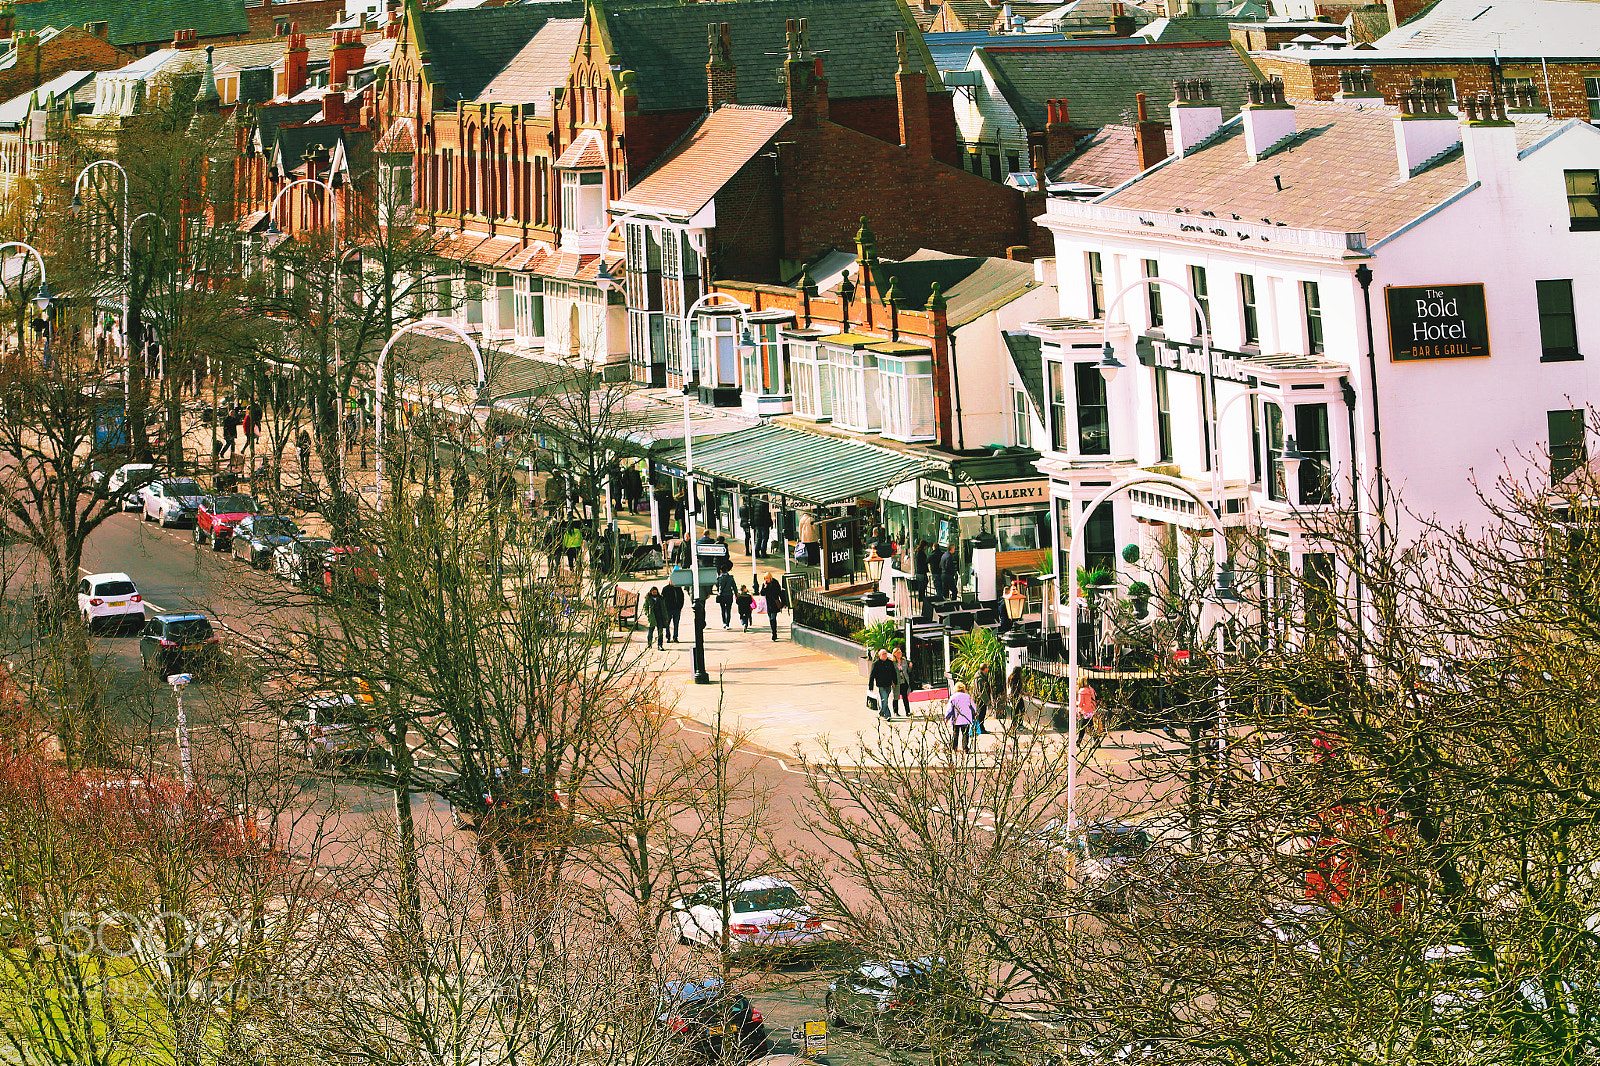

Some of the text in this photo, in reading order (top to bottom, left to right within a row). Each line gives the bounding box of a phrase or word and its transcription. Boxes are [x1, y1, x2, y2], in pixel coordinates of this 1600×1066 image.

[1425, 289, 1444, 299] The
[1416, 298, 1459, 318] Bold
[1412, 320, 1467, 341] Hotel
[1151, 340, 1178, 369] The
[1412, 344, 1470, 357] BAR & GRILL
[981, 487, 1043, 501] GALLERY 1
[832, 526, 847, 541] Bold
[831, 549, 850, 564] Hotel
